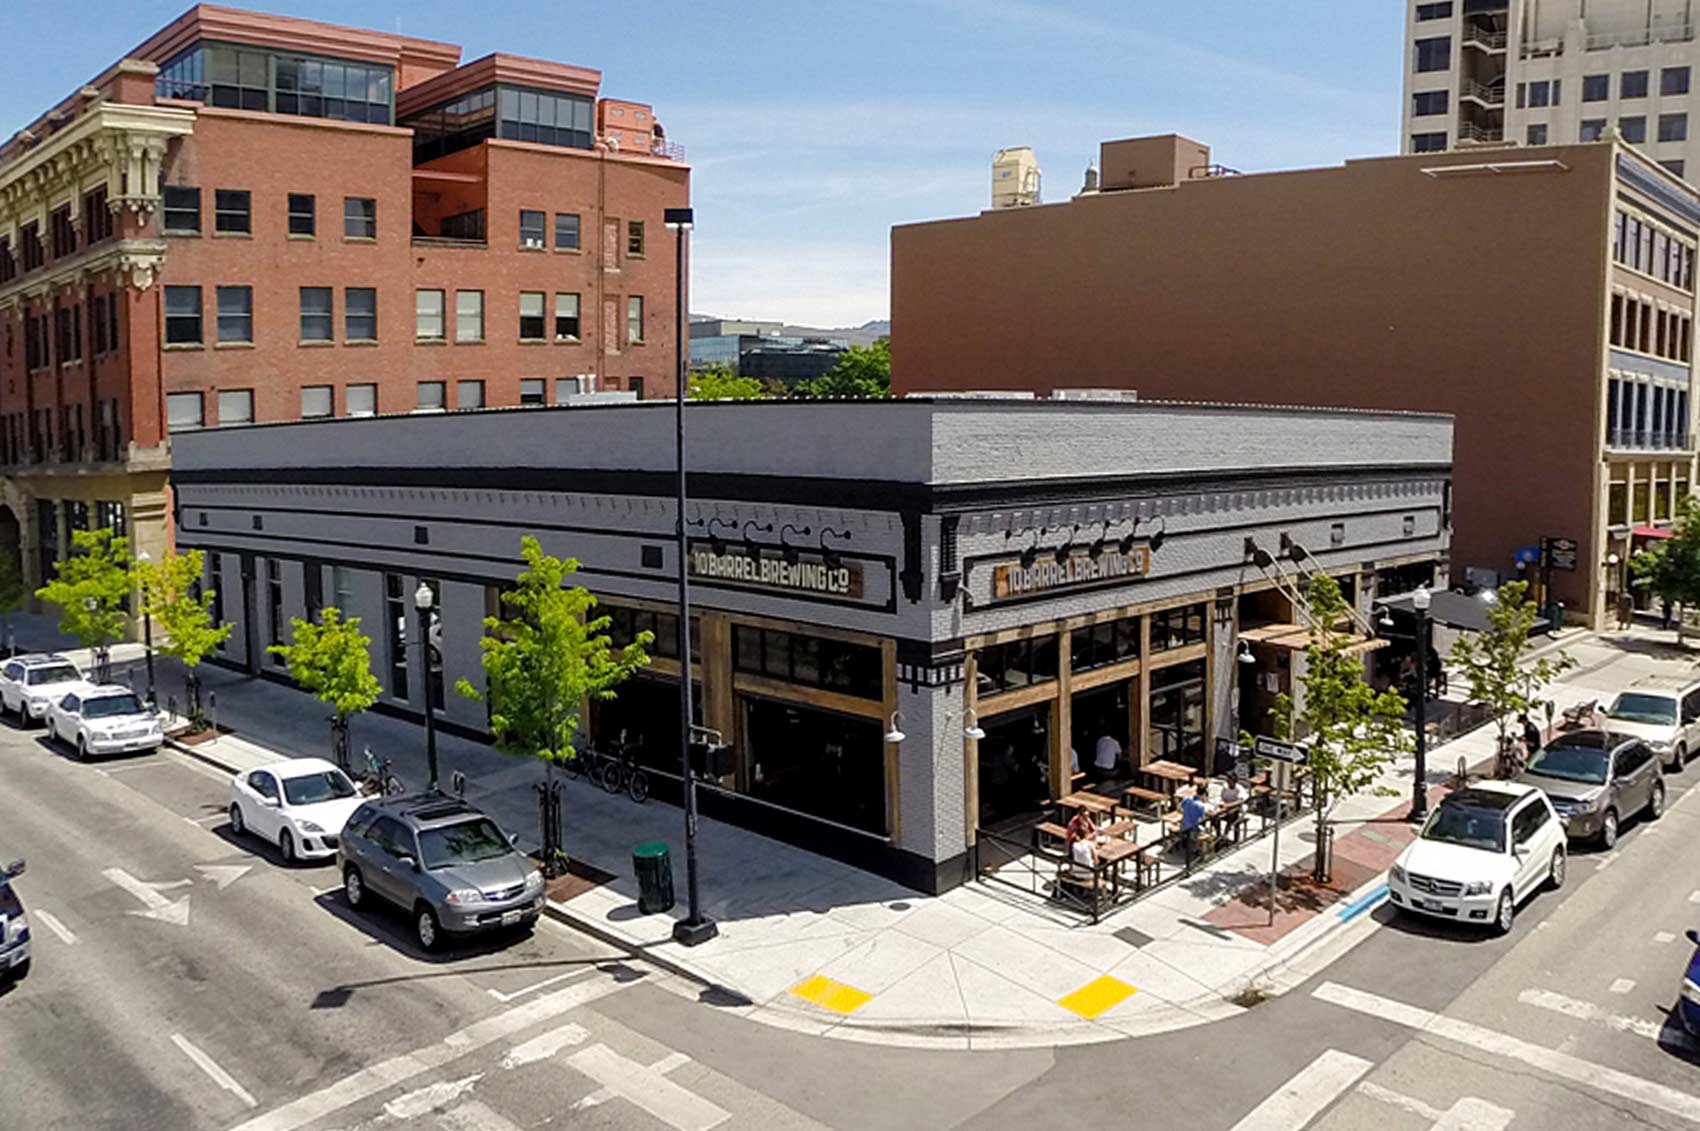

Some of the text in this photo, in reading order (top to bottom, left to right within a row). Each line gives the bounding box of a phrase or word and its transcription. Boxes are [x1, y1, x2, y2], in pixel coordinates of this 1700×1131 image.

[708, 553, 759, 580] BARREL
[760, 559, 825, 590] BREWING
[1023, 558, 1073, 590] BARREL
